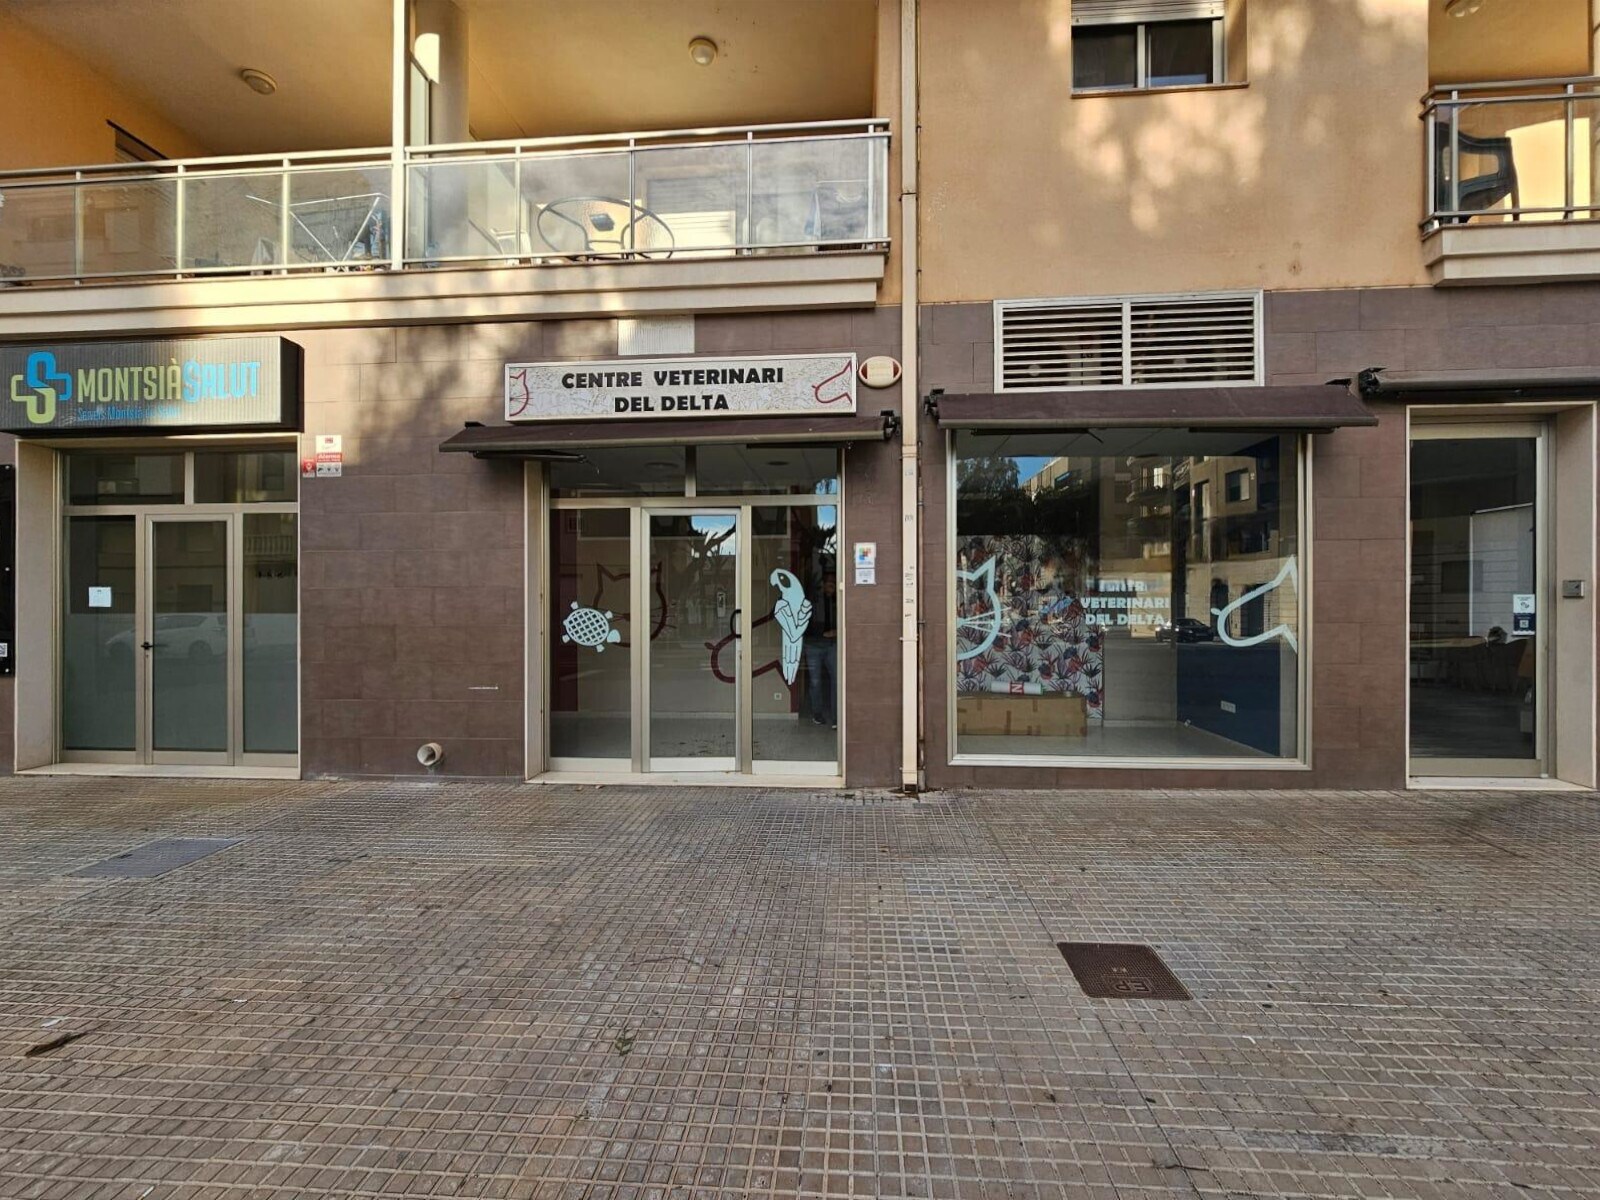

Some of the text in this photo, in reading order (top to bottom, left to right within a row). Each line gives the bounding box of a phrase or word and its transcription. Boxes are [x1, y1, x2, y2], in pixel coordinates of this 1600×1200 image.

[561, 367, 784, 389] CENTRE VETERINARI
[614, 394, 729, 412] DEL DELTA
[1081, 596, 1171, 609] VETERINARI
[1085, 613, 1165, 625] DEL DELTA
